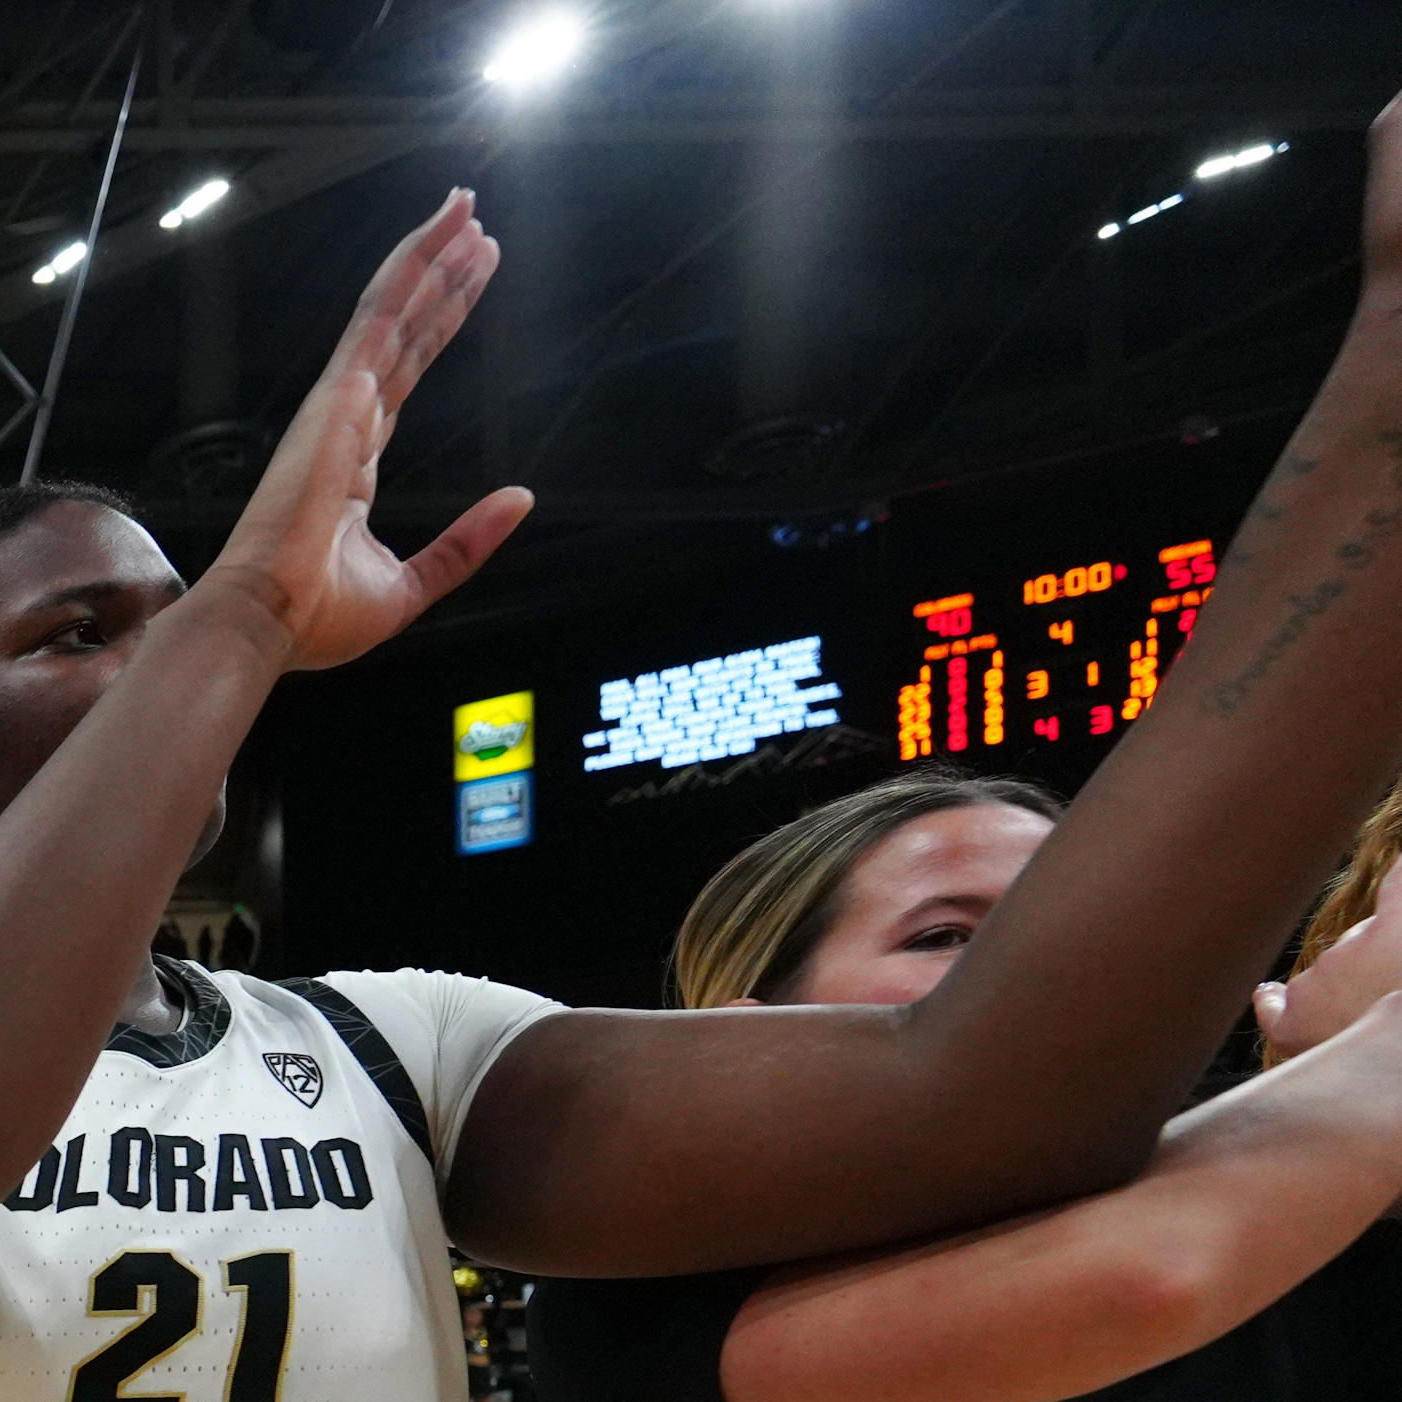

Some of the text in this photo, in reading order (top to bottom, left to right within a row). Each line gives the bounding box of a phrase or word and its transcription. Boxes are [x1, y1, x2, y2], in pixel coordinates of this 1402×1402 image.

[1023, 561, 1112, 606] 10:00
[1048, 619, 1074, 645] 4
[1026, 661, 1099, 700] 3 1
[1090, 704, 1114, 735] 3
[267, 1055, 318, 1083] PAC
[285, 1074, 315, 1093] 12
[1, 1126, 374, 1213] OLORADO
